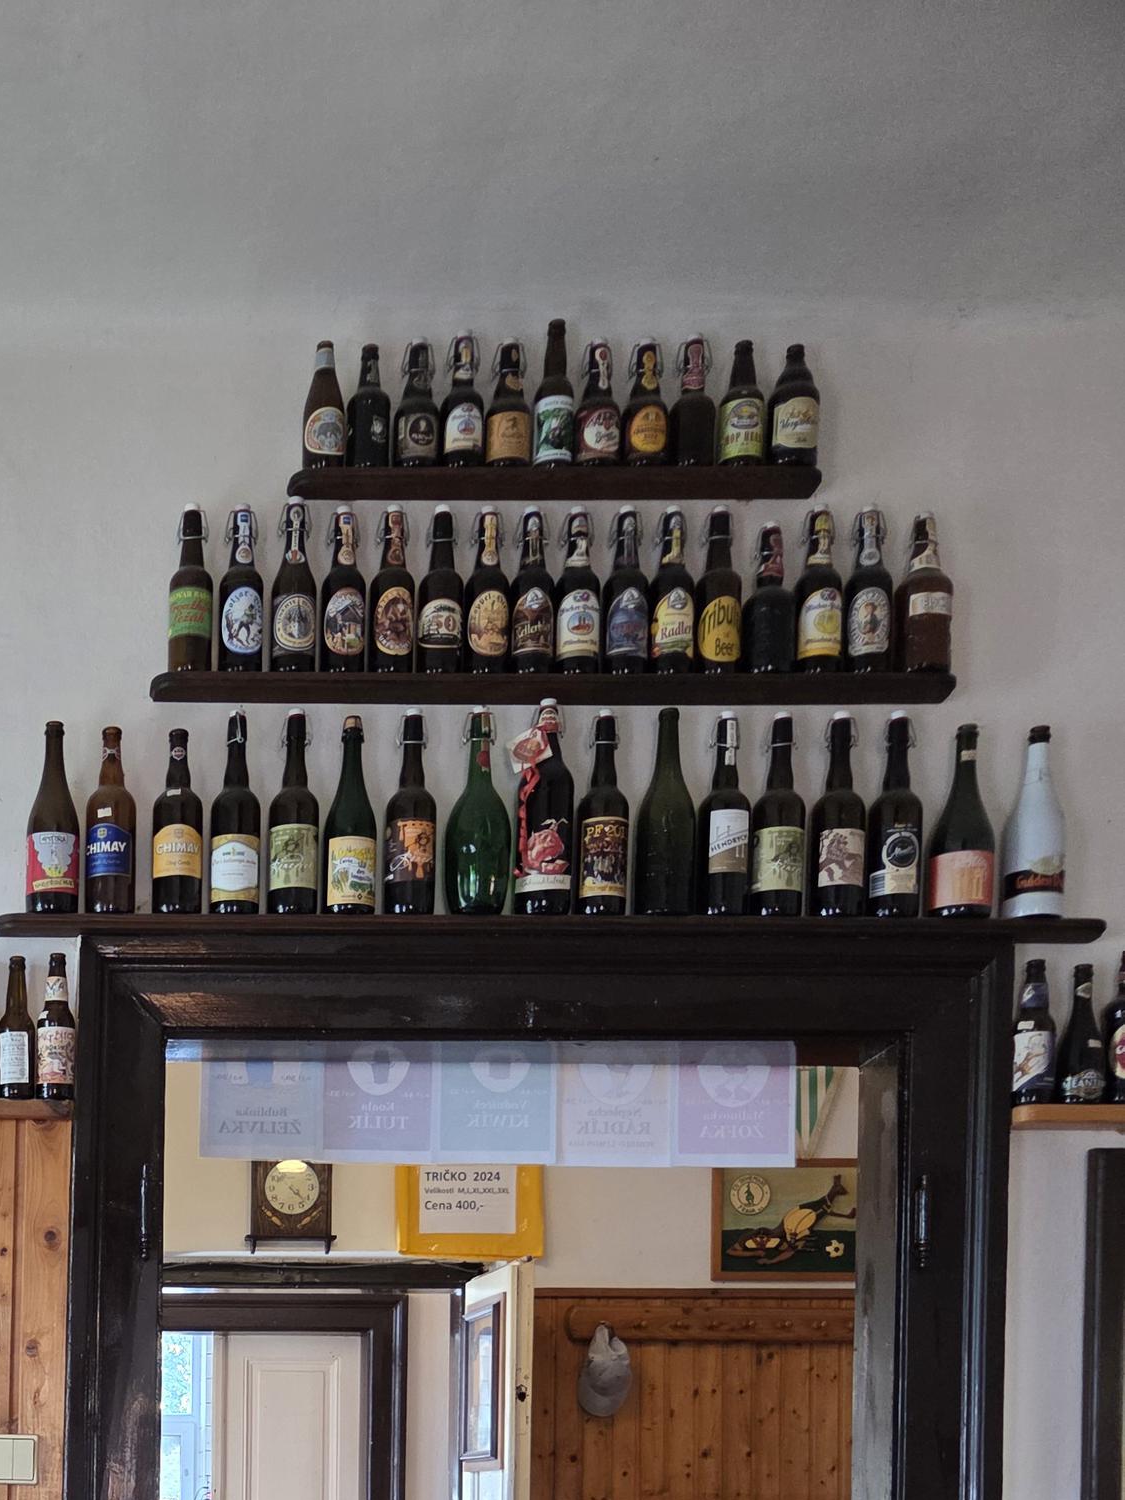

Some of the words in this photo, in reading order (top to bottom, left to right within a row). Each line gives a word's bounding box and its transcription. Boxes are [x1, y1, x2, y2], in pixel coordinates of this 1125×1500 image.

[660, 624, 693, 640] Radler
[715, 637, 735, 656] Beer
[86, 841, 127, 856] CHIMAY
[156, 842, 200, 856] CHIMAY
[424, 1168, 467, 1182] TRIČKO
[473, 1171, 501, 1182] 2024
[424, 1200, 453, 1210] Cena
[455, 1199, 484, 1212] 400,-
